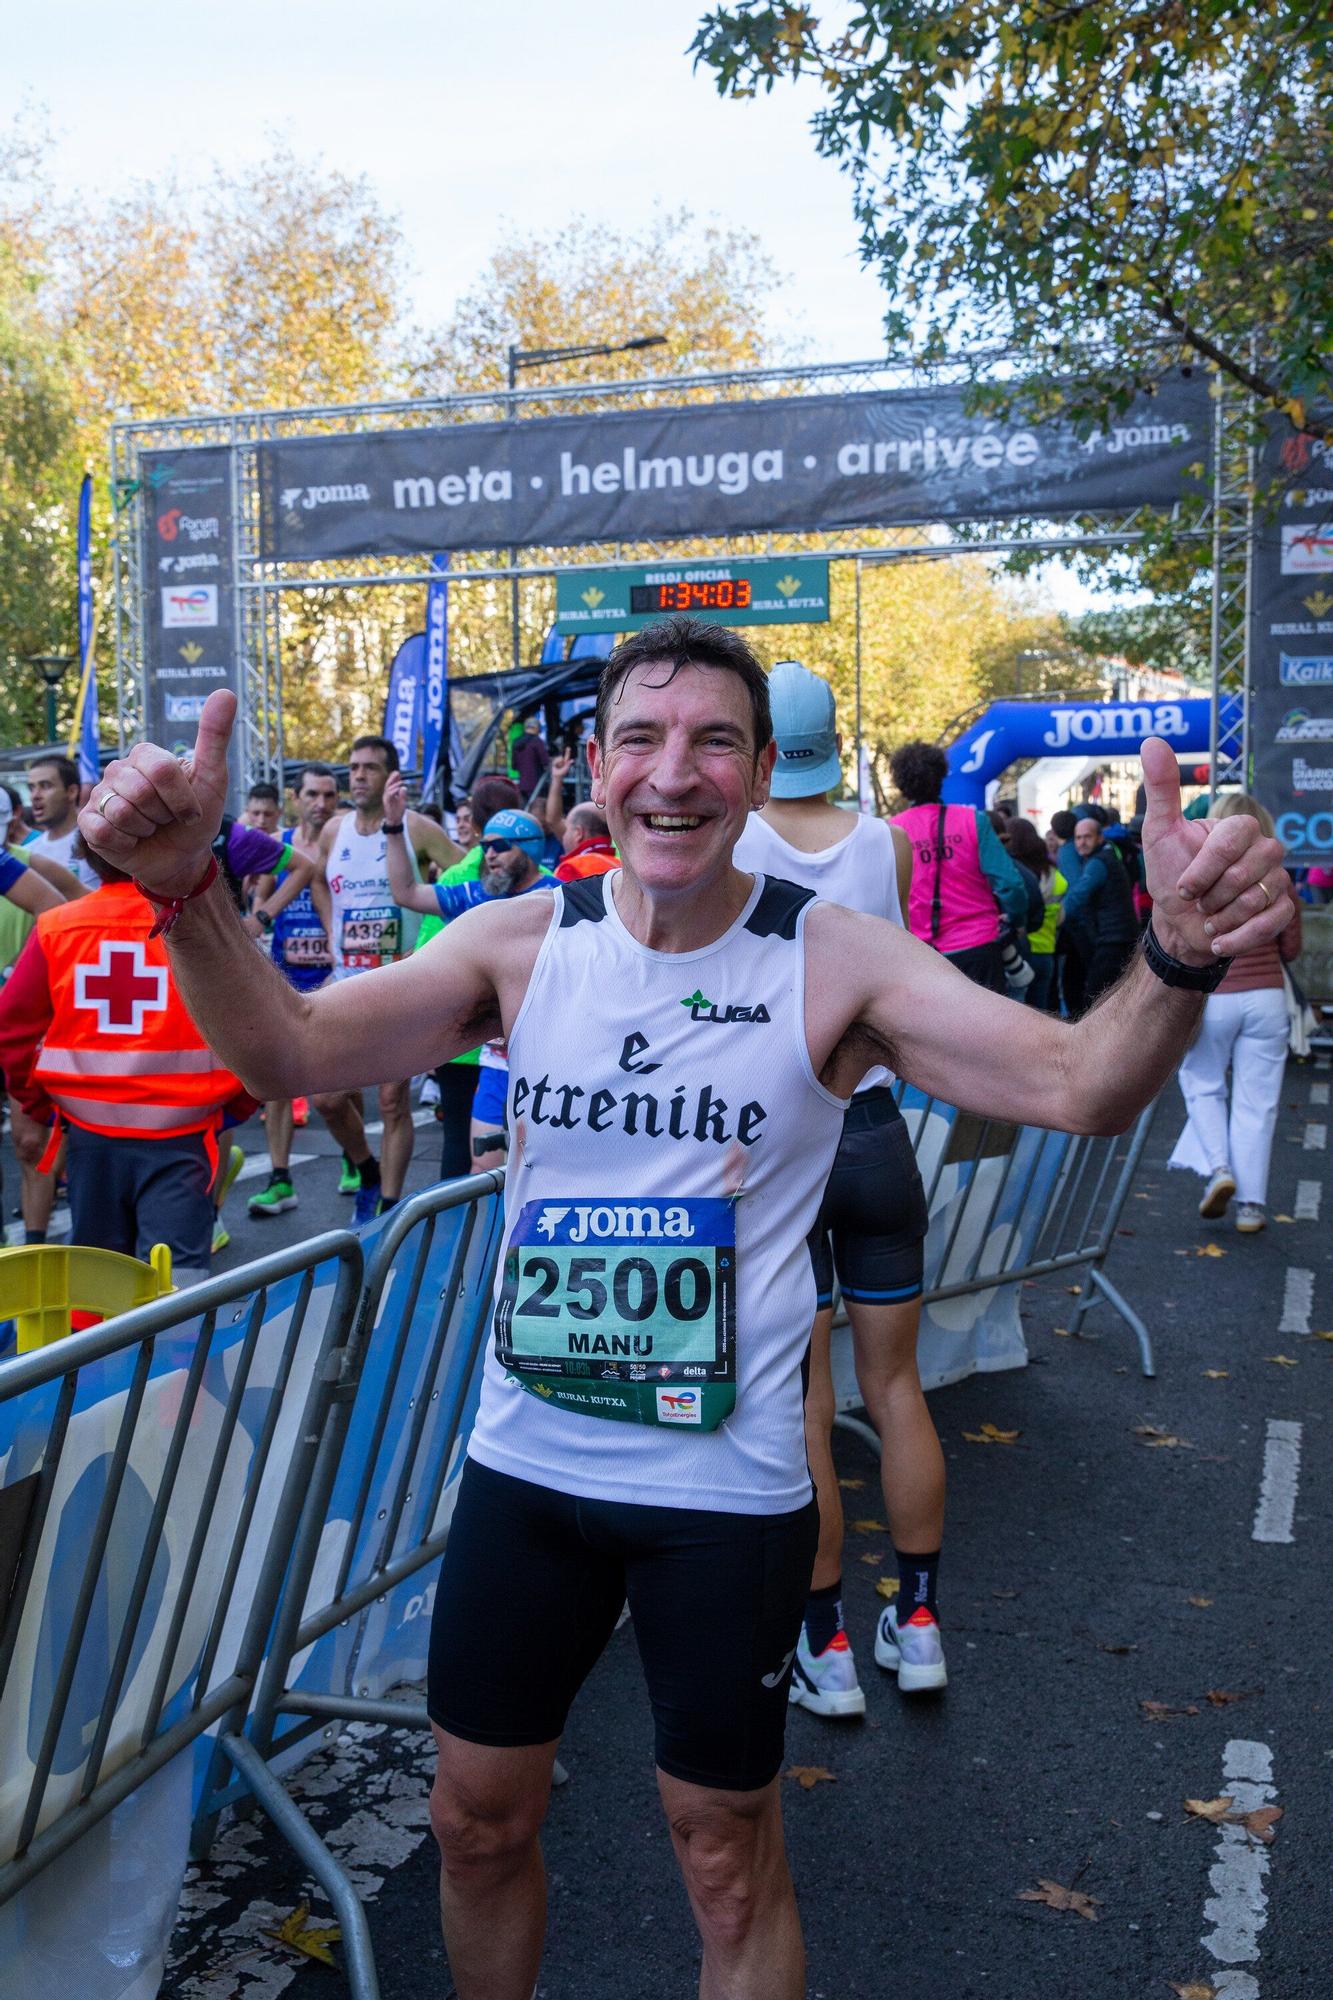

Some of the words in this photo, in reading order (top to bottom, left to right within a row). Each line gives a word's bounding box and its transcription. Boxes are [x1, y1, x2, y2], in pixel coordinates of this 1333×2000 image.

[1107, 423, 1191, 453] Joma
[393, 466, 512, 509] meta
[561, 448, 783, 496] helmuga
[837, 425, 1038, 477] arrivée
[302, 483, 371, 509] Joma
[174, 553, 220, 573] Joma
[645, 573, 681, 585] RELOJ
[685, 570, 732, 582] OFICIAL
[659, 580, 752, 609] 1:34:03
[427, 593, 445, 731] Joma
[392, 673, 417, 768] oma
[1043, 705, 1190, 748] Joma
[347, 922, 397, 940] 4384
[690, 1002, 772, 1024] LUGA
[569, 1206, 696, 1243] Joma
[515, 1256, 712, 1322] 2500
[568, 1333, 654, 1357] MANU
[683, 1366, 707, 1376] delta
[556, 1391, 589, 1403] RURAL
[590, 1396, 627, 1408] KUTXA
